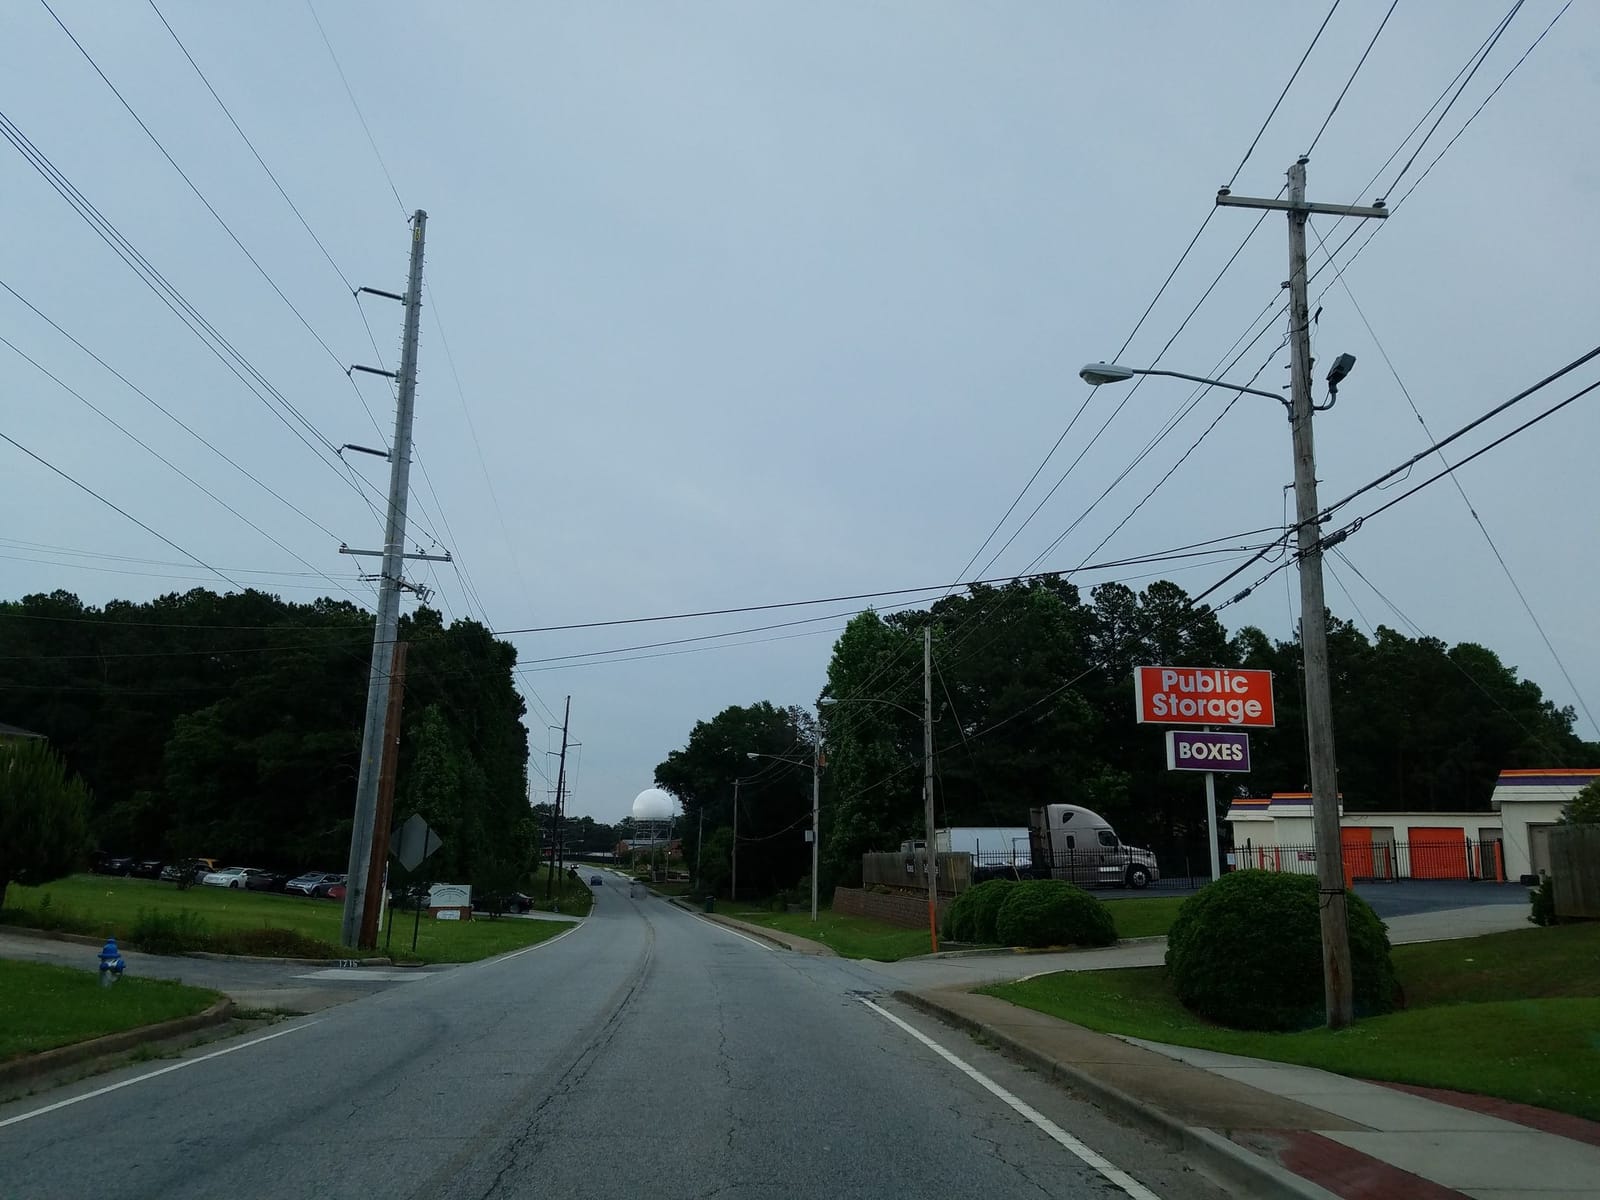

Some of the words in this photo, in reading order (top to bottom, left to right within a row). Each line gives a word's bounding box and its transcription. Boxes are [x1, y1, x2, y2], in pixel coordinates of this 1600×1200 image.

[1162, 671, 1248, 693] Public
[1153, 694, 1262, 723] Storage
[1179, 743, 1243, 761] BOXES
[339, 959, 360, 969] 1715
